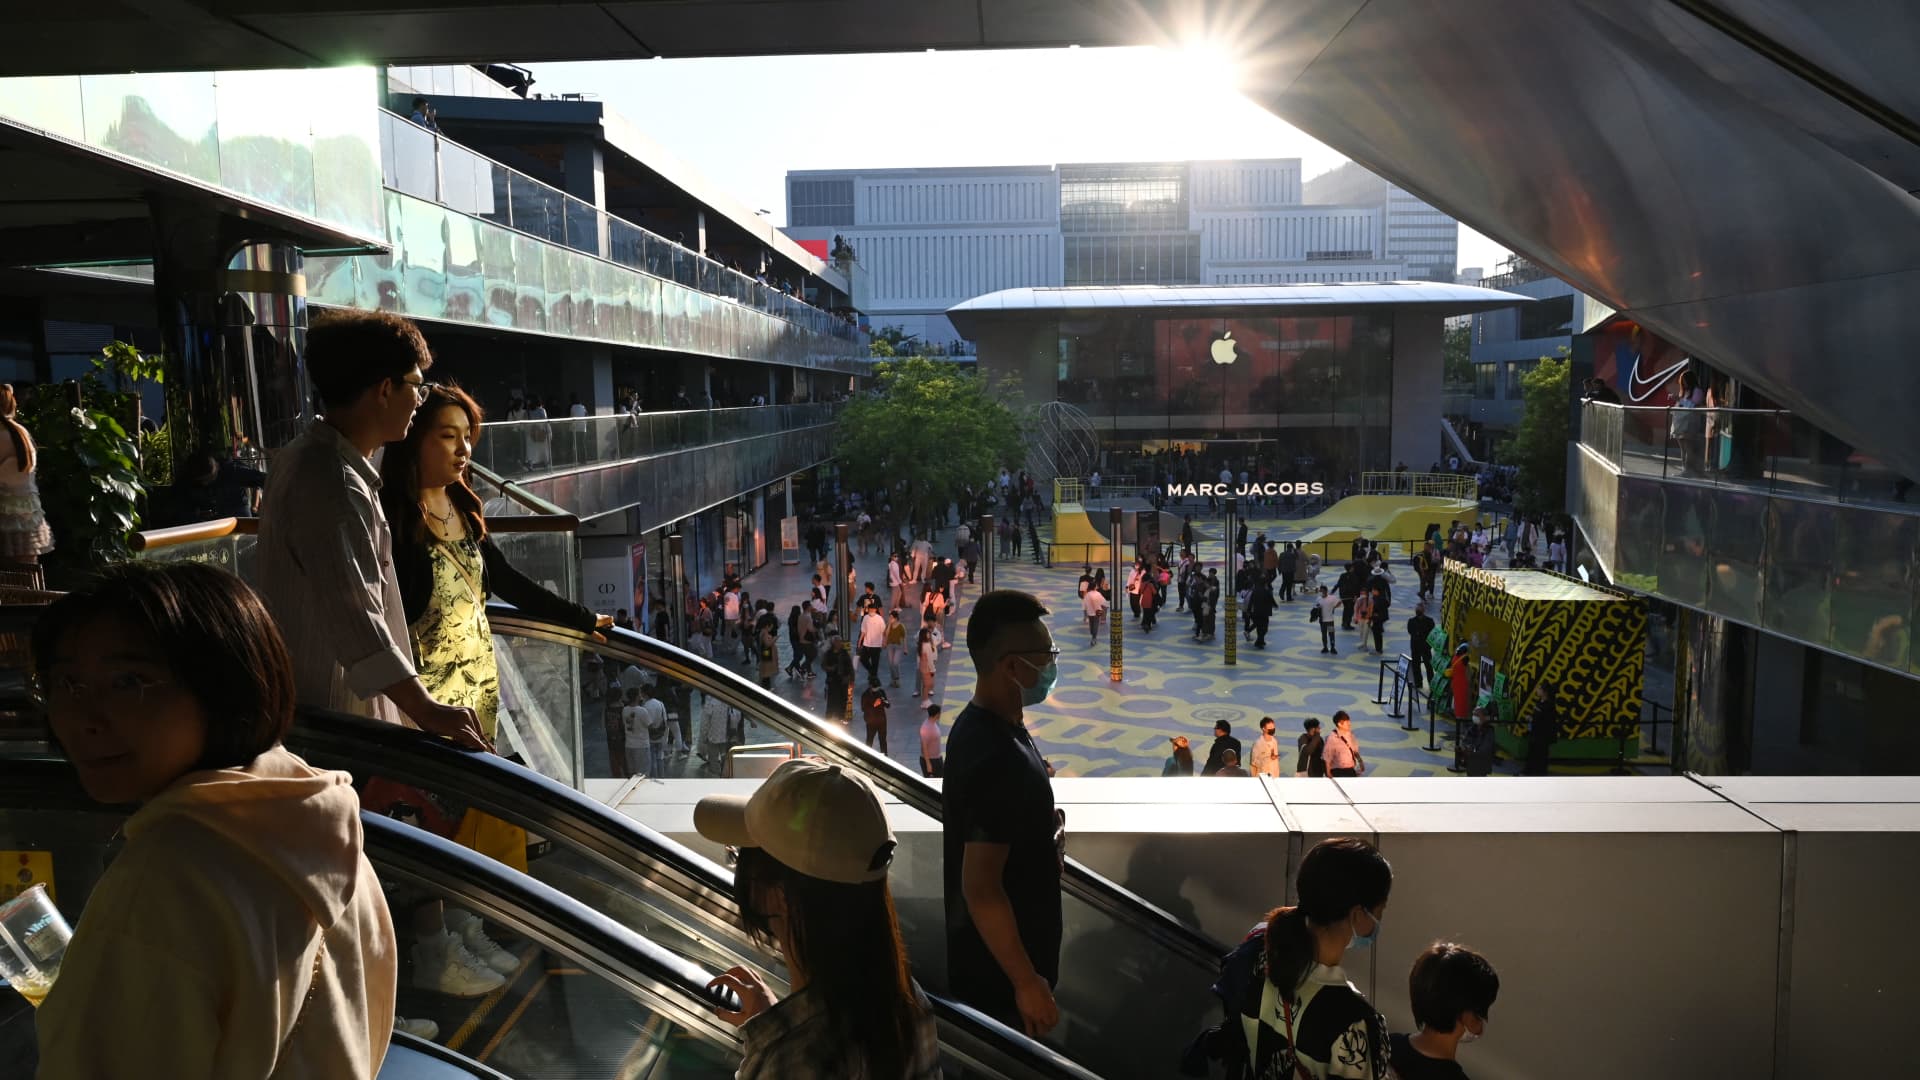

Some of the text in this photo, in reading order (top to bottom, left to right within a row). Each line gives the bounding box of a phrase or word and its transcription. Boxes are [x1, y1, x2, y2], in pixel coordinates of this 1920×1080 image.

[1168, 482, 1324, 497] MARC JACOBS
[1443, 556, 1504, 590] MARC JACOBS
